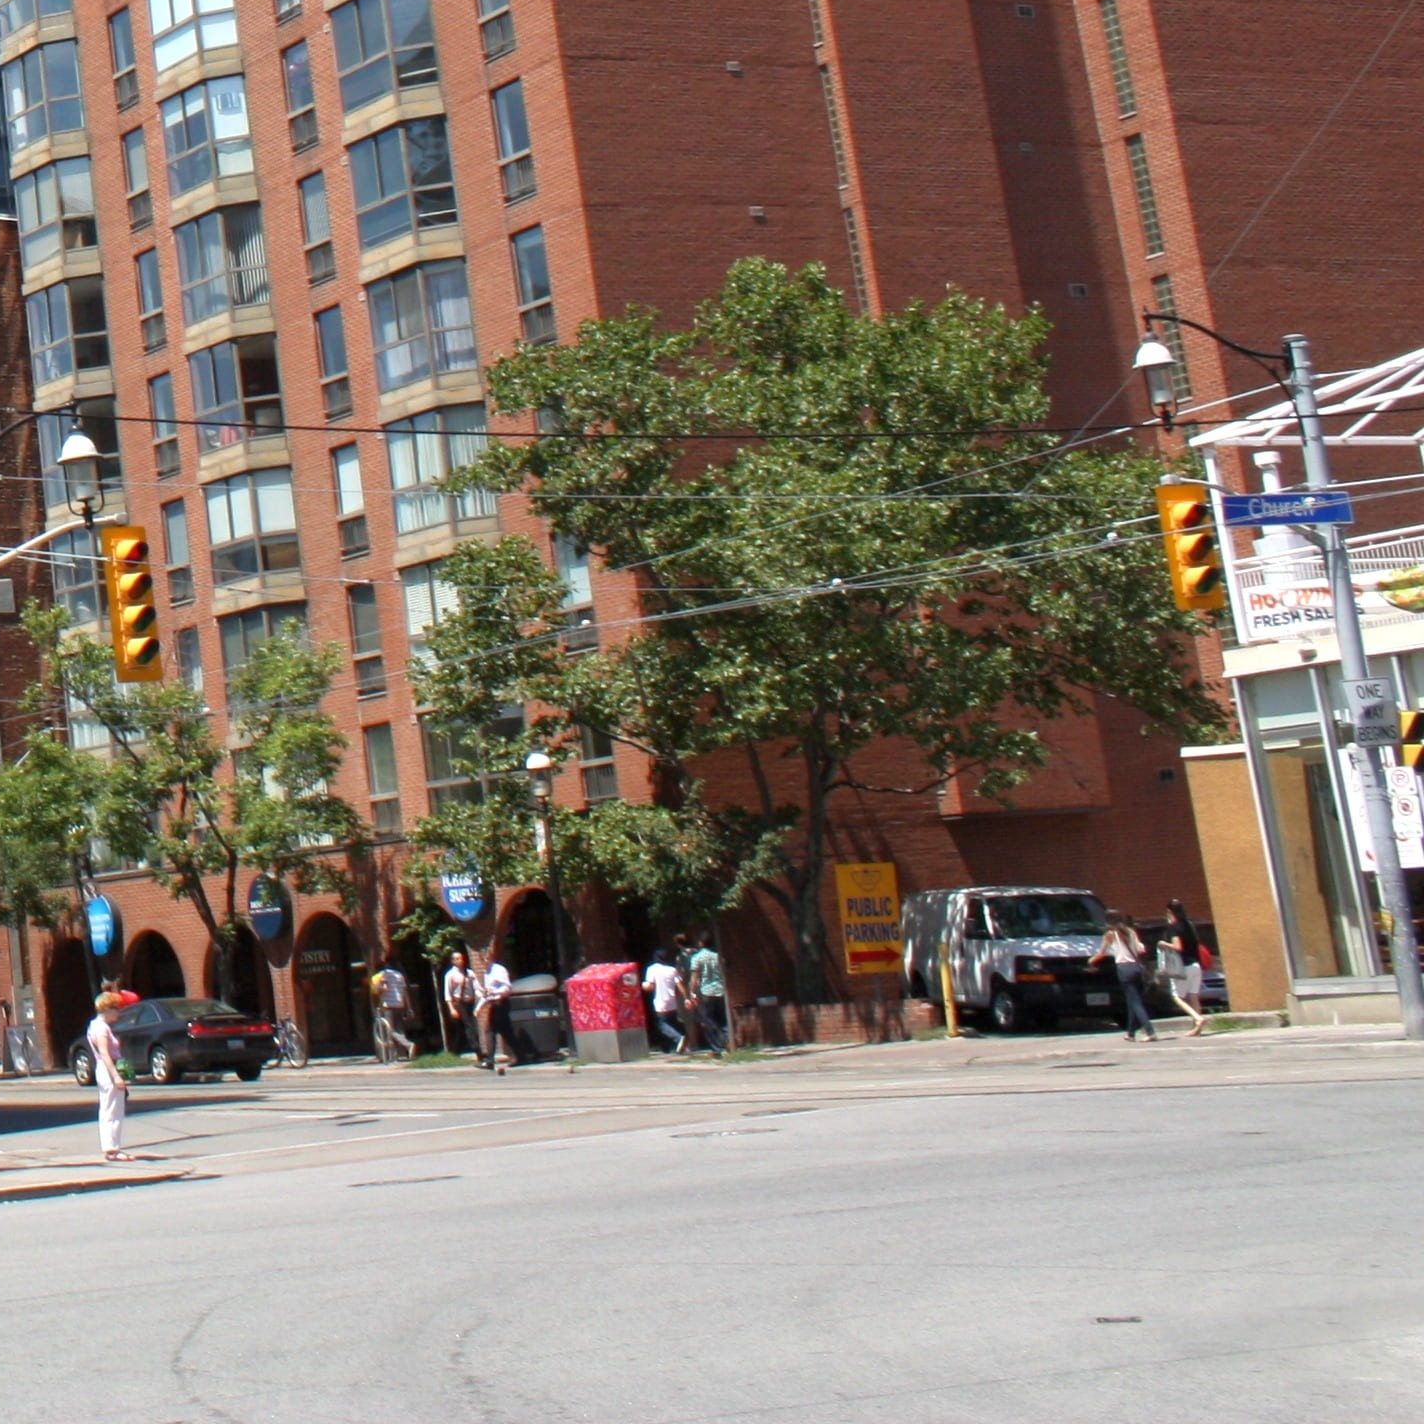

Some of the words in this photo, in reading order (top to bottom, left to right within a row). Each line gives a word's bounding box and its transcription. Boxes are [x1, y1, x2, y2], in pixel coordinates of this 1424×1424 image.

[1248, 497, 1316, 518] Church
[1254, 610, 1302, 628] FRESH
[1305, 602, 1365, 621] SALS
[1356, 685, 1383, 699] ONE
[1362, 704, 1384, 719] WAY
[1358, 726, 1397, 742] BEGINS
[847, 897, 892, 917] PUBLIC
[845, 922, 900, 943] PARKING
